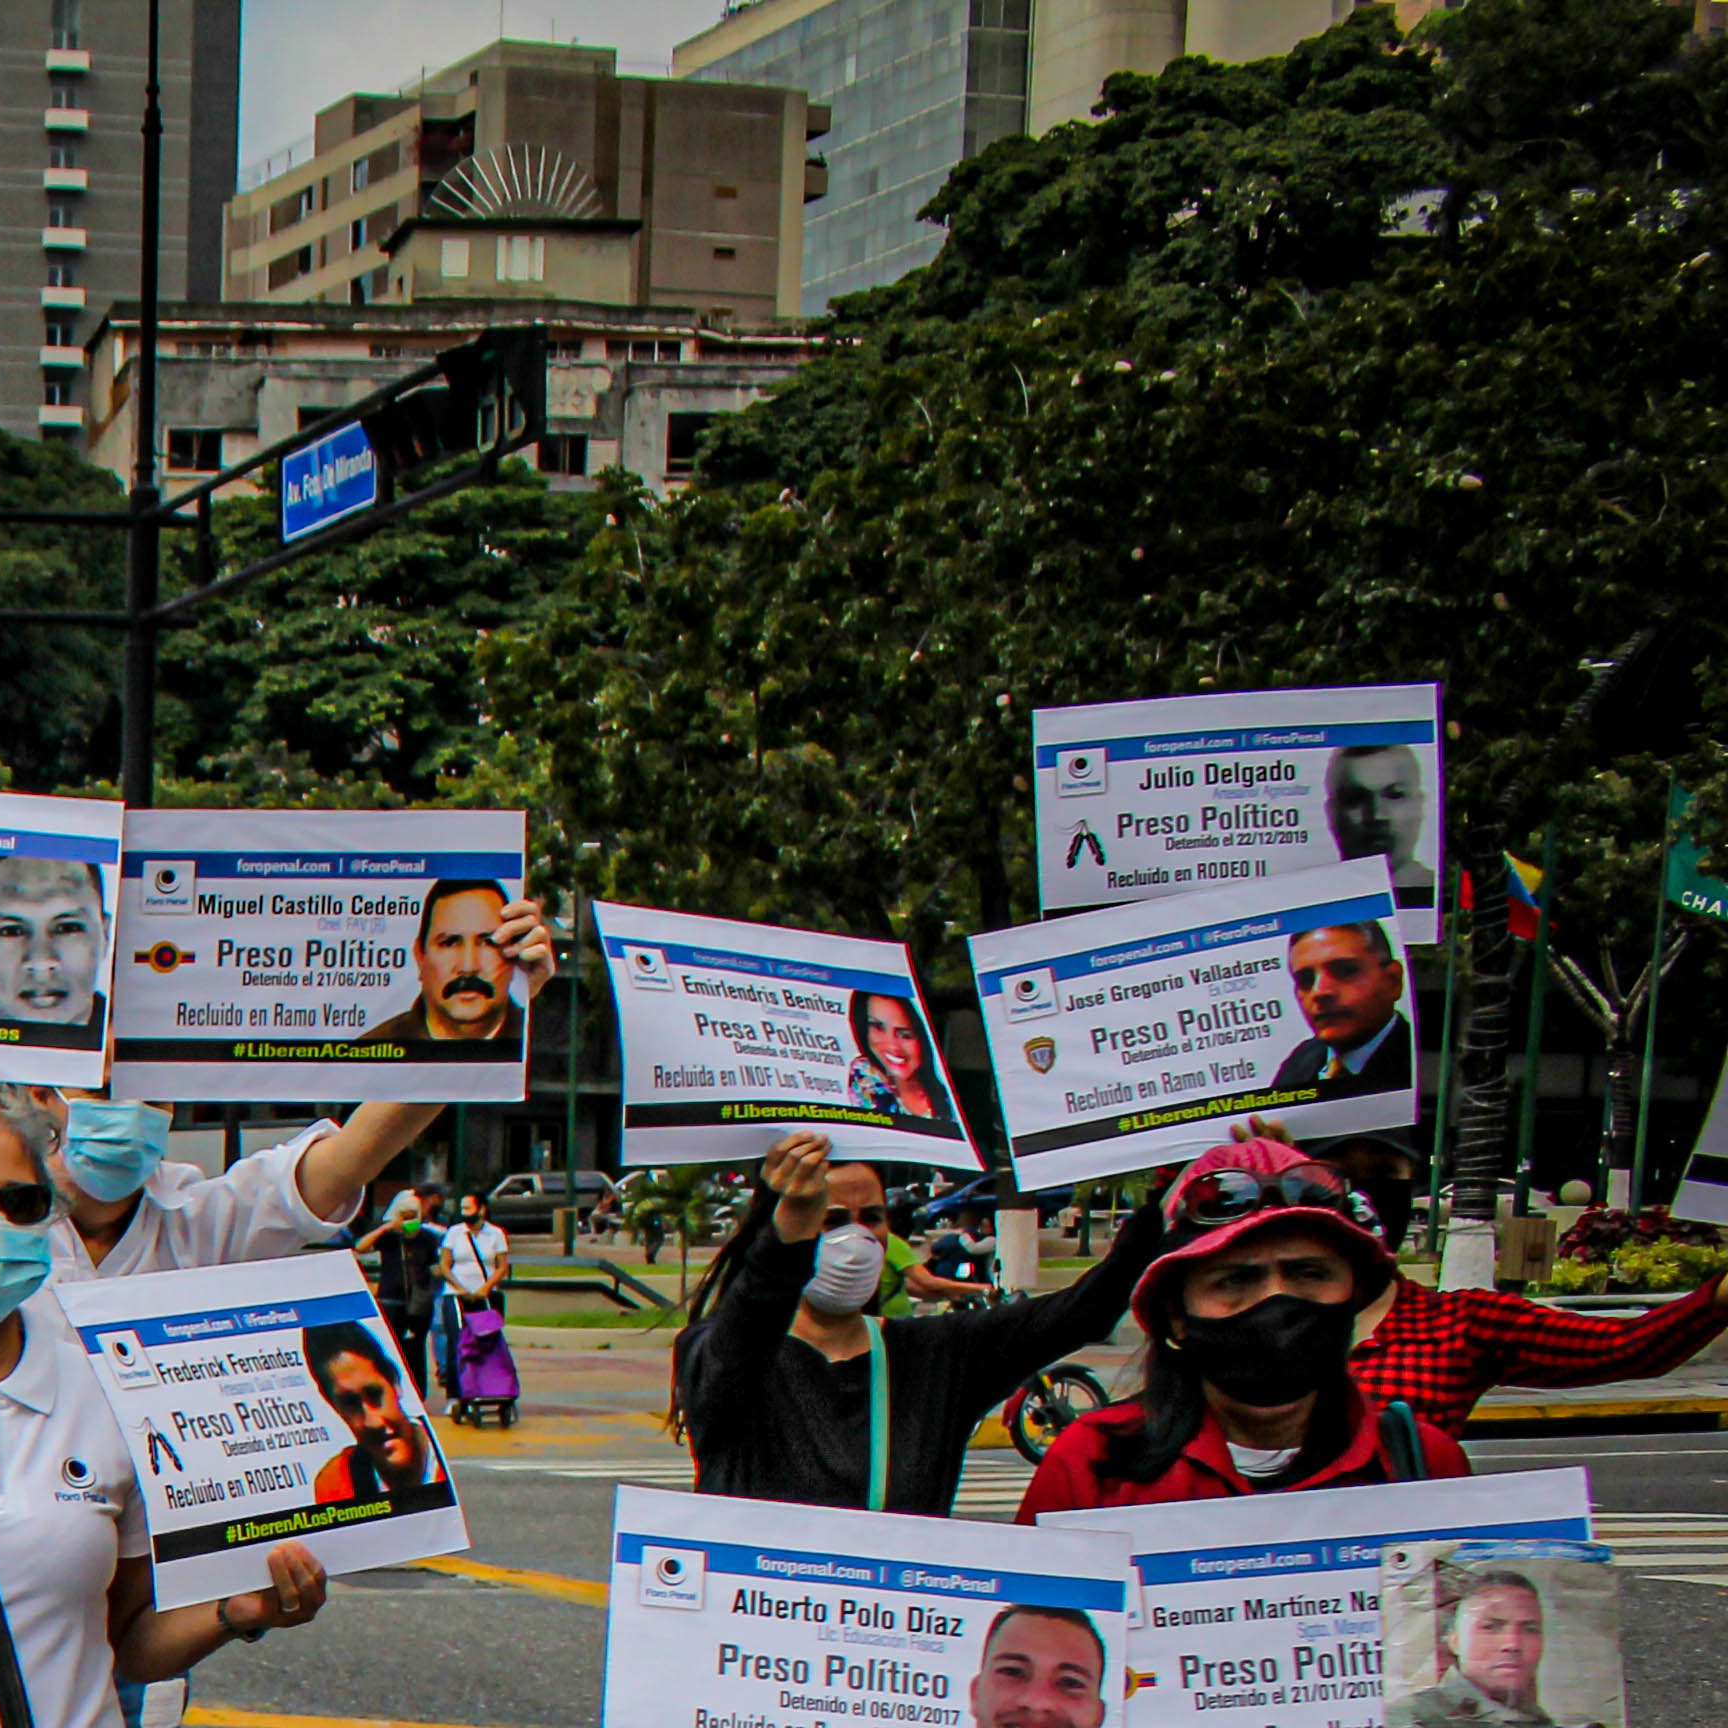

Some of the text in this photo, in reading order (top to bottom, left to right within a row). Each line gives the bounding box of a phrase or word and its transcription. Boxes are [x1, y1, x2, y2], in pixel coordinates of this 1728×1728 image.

[1140, 760, 1296, 791] Julio Delgado
[1117, 803, 1299, 838] Preso Político
[1107, 860, 1266, 888] Recluido en RODEO II
[198, 894, 420, 918] Miguel Castillo Cedeño
[217, 938, 406, 968] Preso Político
[242, 972, 390, 987] Detenido el 21/06/2019
[682, 975, 778, 1005] Emirlendris
[784, 988, 845, 1015] Benítez
[1065, 989, 1105, 1012] José
[1111, 973, 1184, 1004] Gregorio
[1190, 956, 1281, 985] Valladares
[177, 1002, 365, 1027] Recluido en Ramo Verde
[695, 1013, 756, 1041] Presa
[762, 1021, 840, 1052] Política
[1091, 999, 1283, 1055] Preso Político
[233, 1043, 404, 1059] #LiberenACastillo
[654, 1065, 714, 1088] Recluida
[722, 1072, 736, 1087] en
[740, 1066, 773, 1087] INOF
[1065, 1058, 1256, 1113] Recluido en Ramo Verde
[722, 1105, 893, 1126] #LiberenAEmirlendris
[1118, 1087, 1317, 1133] #LiberenAValladares
[156, 1349, 303, 1384] Frederick Fernández
[171, 1398, 314, 1443] Preso Político
[165, 1462, 307, 1508] Recluido en RODEO II
[226, 1500, 391, 1542] #LiberenALosPemones
[733, 1589, 964, 1637] Alberto Polo Díaz
[1153, 1603, 1234, 1628] Geomar
[1244, 1592, 1342, 1621] Martínez
[718, 1643, 950, 1698] Preso Político
[1180, 1640, 1383, 1689] Preso Políti
[780, 1691, 959, 1726] Detenido el 06/08/2017
